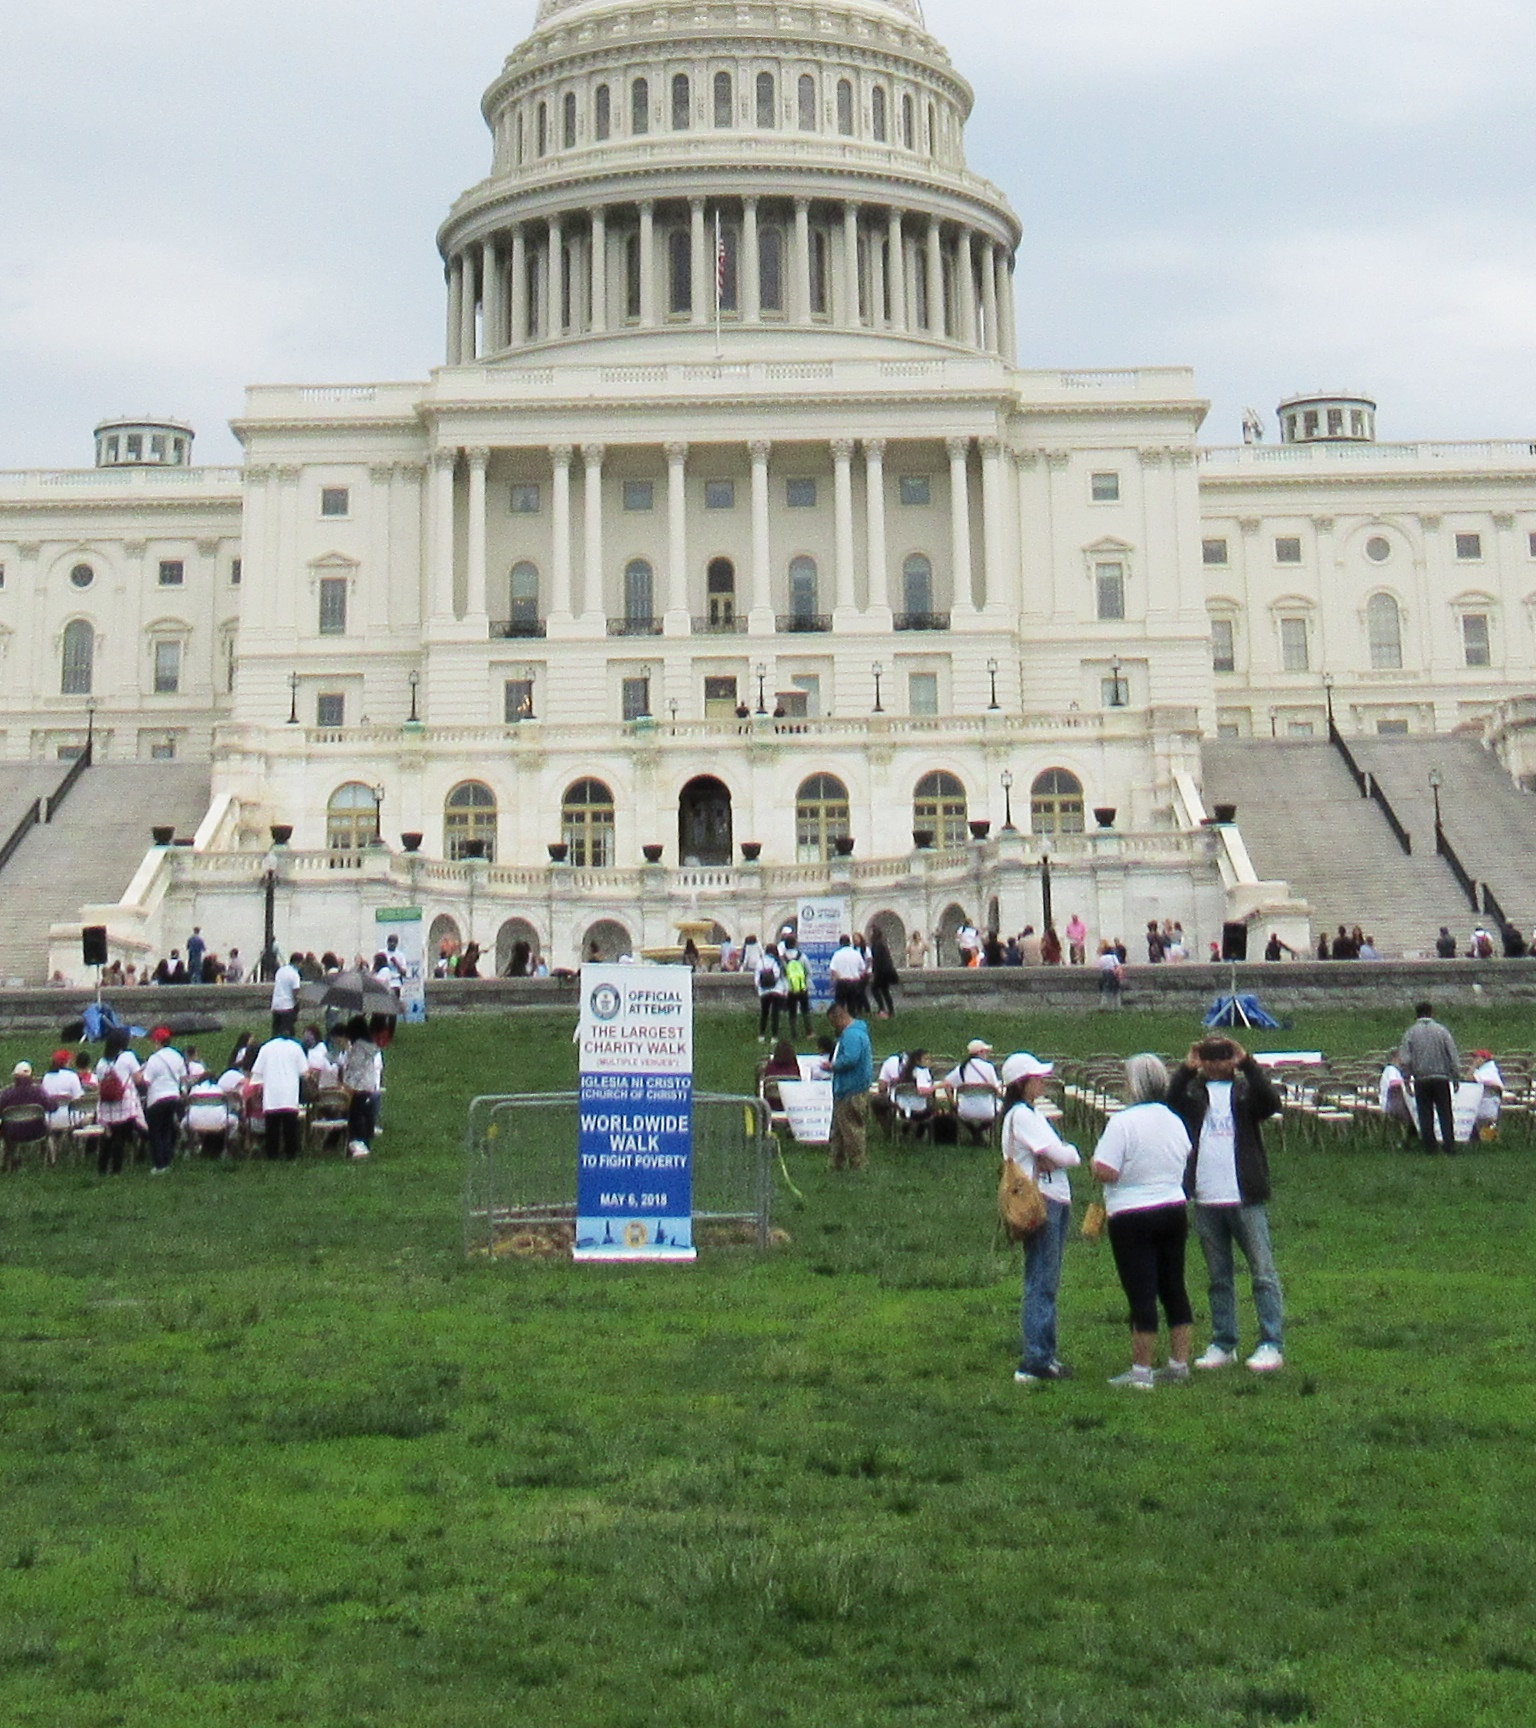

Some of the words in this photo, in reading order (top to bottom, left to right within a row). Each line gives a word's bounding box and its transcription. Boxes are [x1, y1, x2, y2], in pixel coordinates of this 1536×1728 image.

[628, 991, 682, 1002] OFFICIAL
[629, 1004, 682, 1015] ATTEMPT
[592, 1026, 616, 1038] THE
[621, 1026, 684, 1039] LARGEST
[585, 1042, 643, 1054] CHARITY
[648, 1042, 686, 1055] WALK
[581, 1076, 629, 1089] IGLESIA
[631, 1076, 643, 1089] NI
[646, 1077, 691, 1089] CRISTO
[581, 1089, 628, 1100] (CHURCH
[630, 1090, 643, 1100] OF
[646, 1090, 687, 1101] CHRIST)
[581, 1114, 688, 1132] WORLDWIDE
[610, 1134, 659, 1152] WALK
[582, 1154, 597, 1168] TO
[599, 1154, 632, 1168] FIGHT
[635, 1154, 687, 1169] POVERTY
[600, 1193, 626, 1206] MAY
[628, 1193, 638, 1207] 6,
[641, 1193, 667, 1206] 2018
